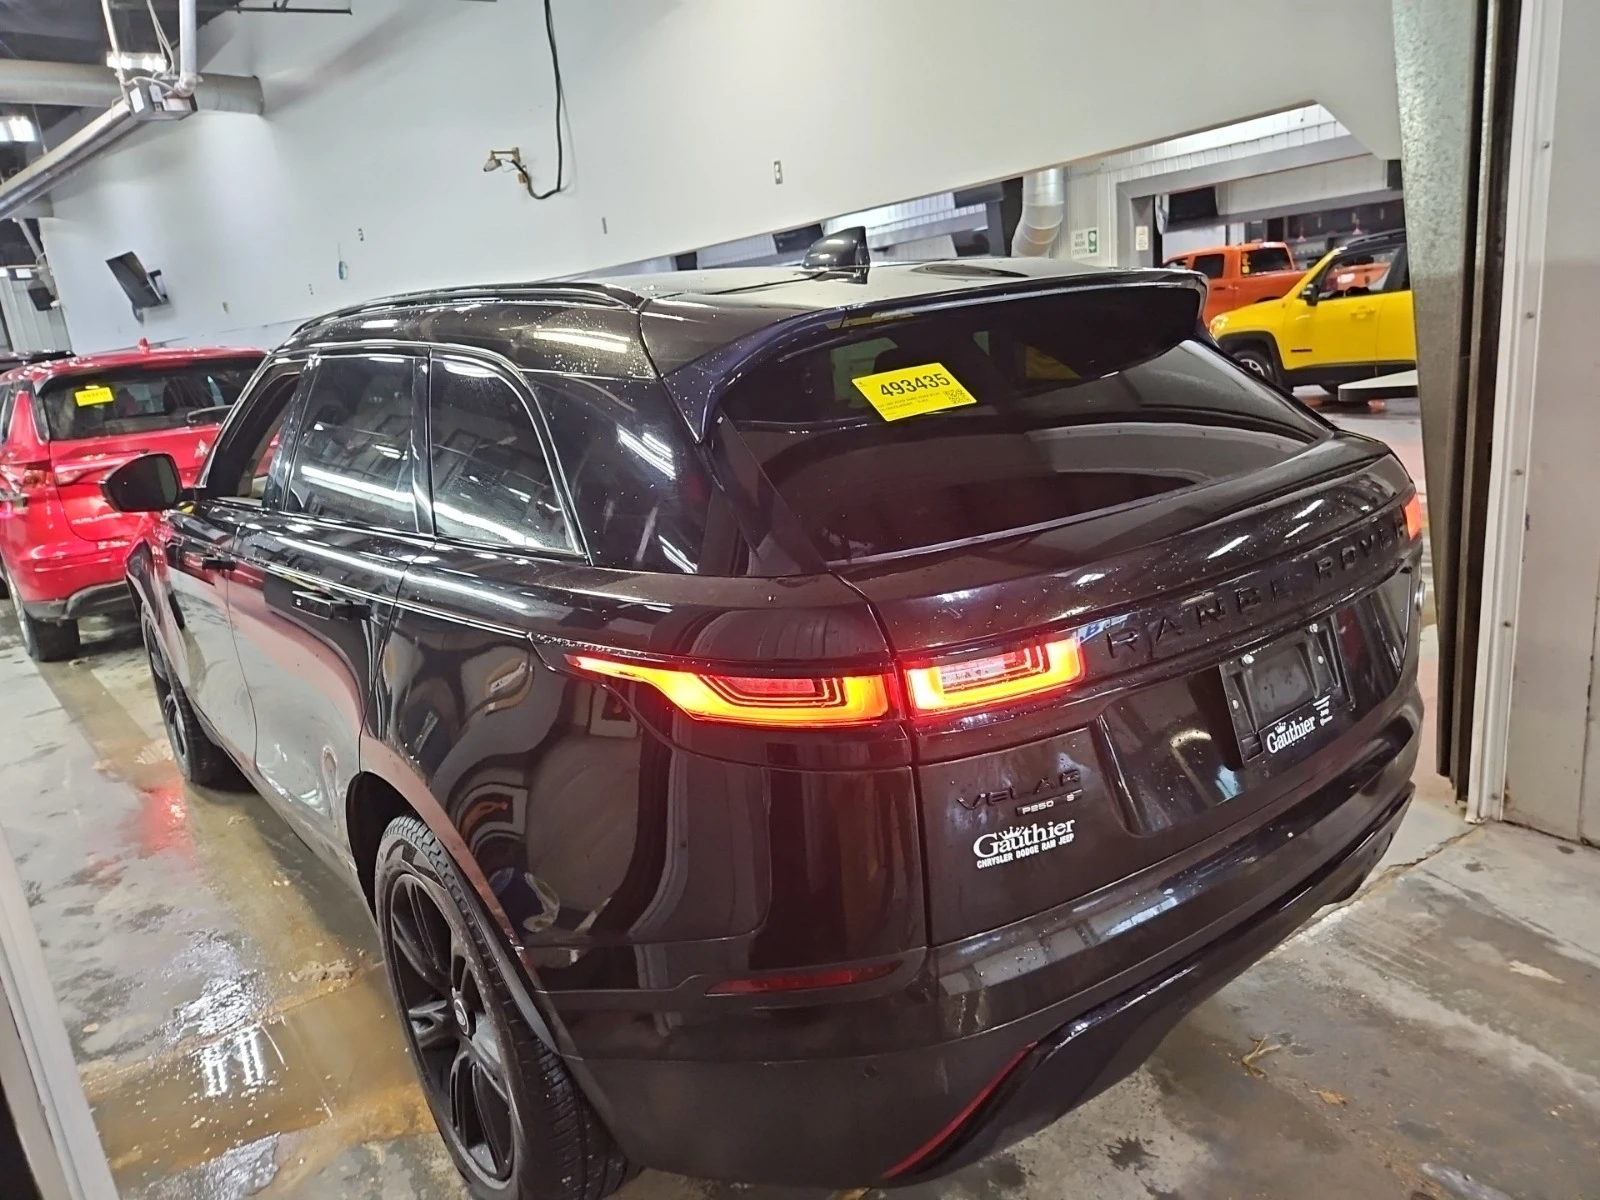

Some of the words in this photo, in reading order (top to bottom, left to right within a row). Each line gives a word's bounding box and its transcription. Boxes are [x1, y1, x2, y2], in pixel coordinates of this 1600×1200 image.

[880, 372, 951, 397] 493435
[1106, 578, 1293, 659] RANGE
[1314, 518, 1405, 584] ROVER
[1266, 716, 1316, 754] Gauthier
[955, 768, 1082, 811] VELAR
[1021, 799, 1055, 816] P250
[972, 819, 1076, 859] Gauthier
[976, 852, 1014, 870] CHRYSLER
[1015, 844, 1040, 860] DODGE
[1041, 838, 1057, 852] RAM
[1058, 833, 1075, 846] JEEP
